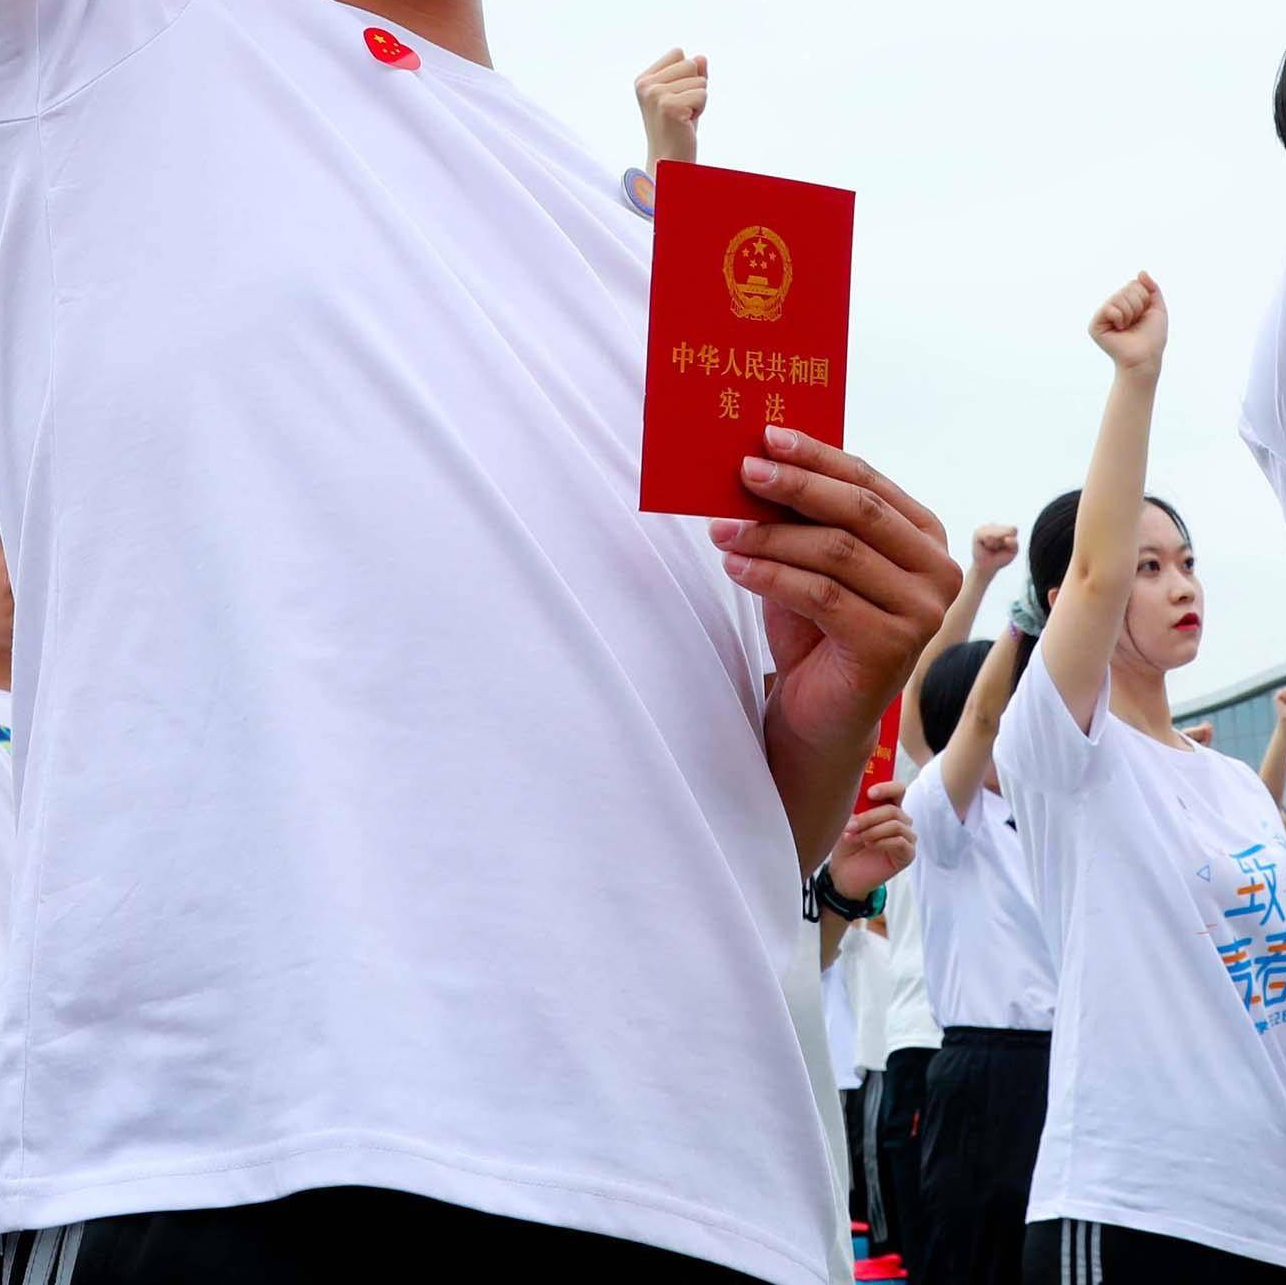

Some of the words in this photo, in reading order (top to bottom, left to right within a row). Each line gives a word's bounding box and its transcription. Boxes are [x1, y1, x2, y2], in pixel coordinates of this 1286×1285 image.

[671, 341, 830, 388] 中华人民共和国
[719, 386, 785, 424] 宪法
[1224, 843, 1286, 926] 致
